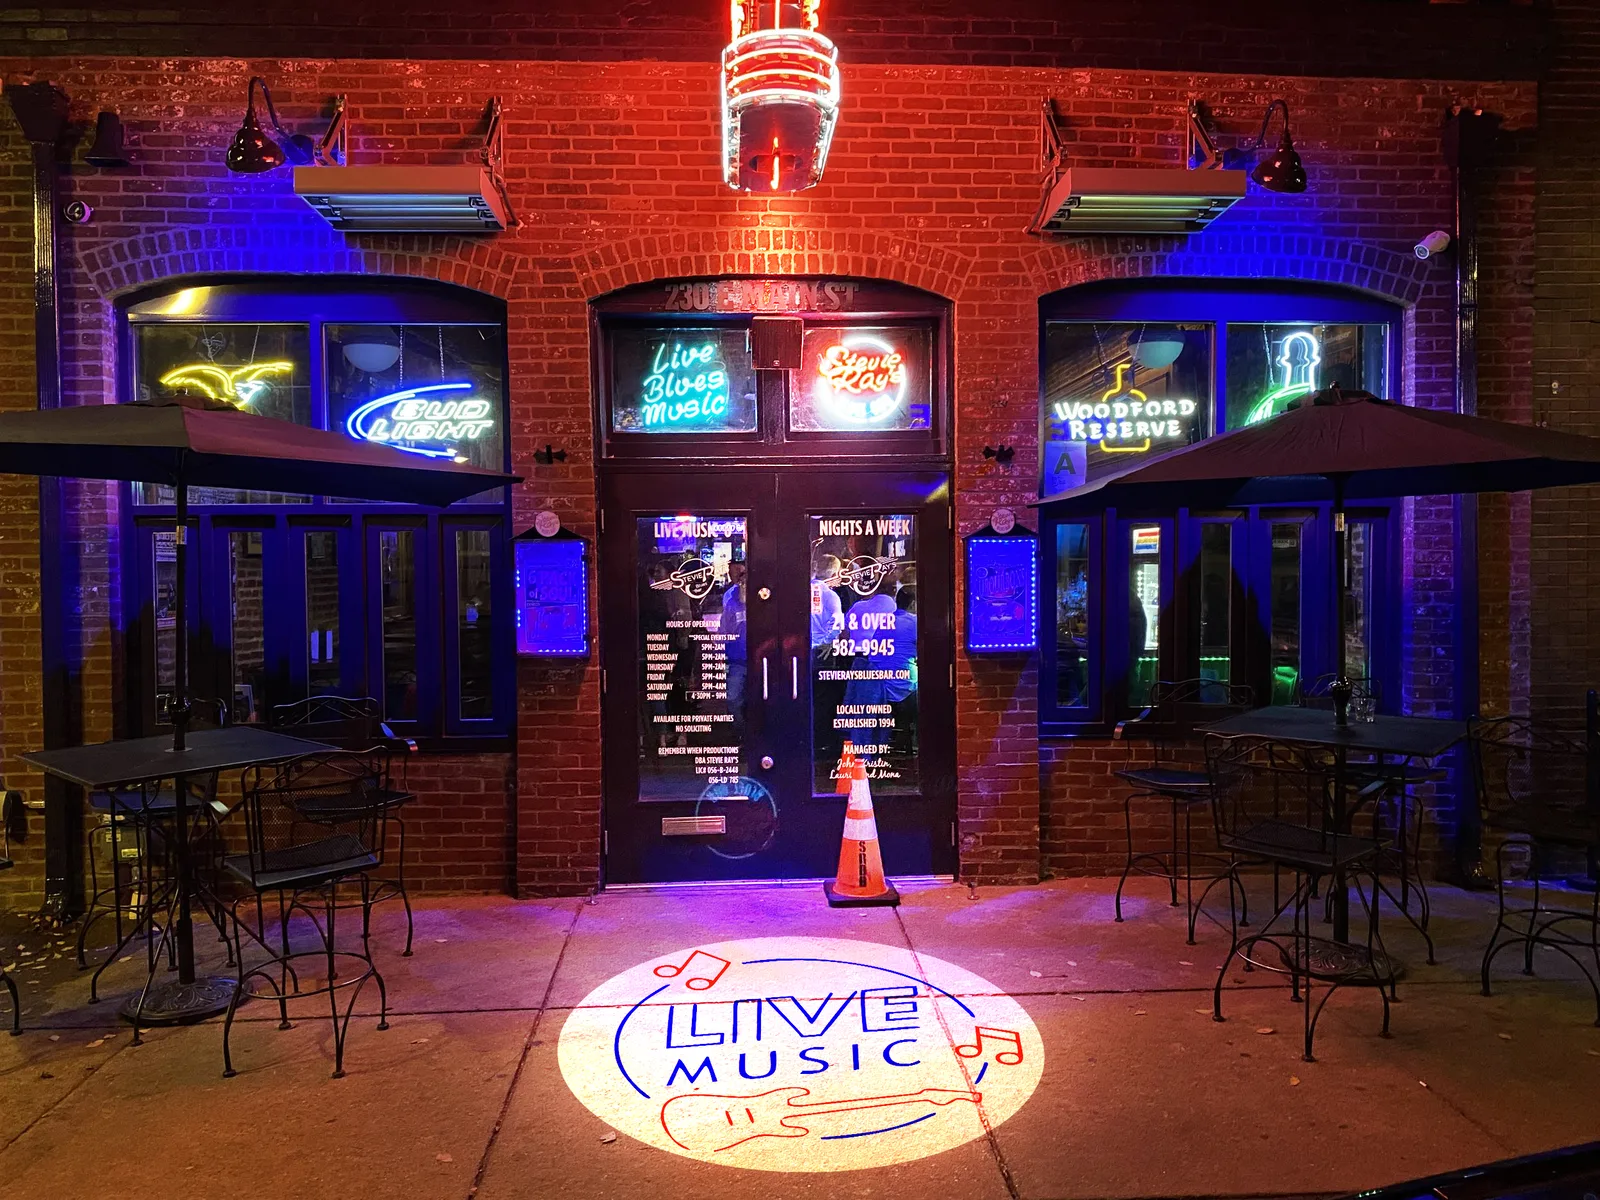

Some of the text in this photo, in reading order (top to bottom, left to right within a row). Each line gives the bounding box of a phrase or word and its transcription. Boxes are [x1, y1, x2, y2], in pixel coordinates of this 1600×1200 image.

[665, 282, 860, 311] 230 E MAIN ST
[653, 343, 714, 374] Live
[818, 346, 902, 376] Stevie
[643, 370, 725, 403] Blues
[828, 365, 904, 394] Ray's
[391, 400, 490, 420] BUD
[1054, 399, 1196, 421] WOODFORD
[366, 418, 494, 440] LIGHT
[1069, 420, 1182, 440] RESERVE
[1054, 452, 1076, 475] A
[654, 522, 679, 537] LIVE
[682, 520, 719, 538] MUSIC
[819, 519, 911, 536] NIGHTS A WEEK
[692, 620, 721, 628] OPERATION
[848, 613, 858, 630] &
[861, 613, 896, 630] OVER
[701, 643, 726, 651] 5PM-2AM
[832, 639, 895, 656] 582-9945
[701, 653, 726, 661] 5PM-2AM
[647, 663, 674, 671] THURSDAY
[818, 670, 911, 680] STEVIERAYSBLUESBAR.COM
[647, 673, 665, 681] FRIDAY
[836, 704, 893, 715] LOCALLY OWNED
[653, 715, 680, 723] AVAILABLE
[833, 718, 896, 728] ESTABLISHED 1994
[658, 747, 686, 755] REMEMBER
[843, 744, 891, 755] MANAGED BY:
[666, 985, 920, 1049] LIVE
[666, 1039, 921, 1086] MUSIC
